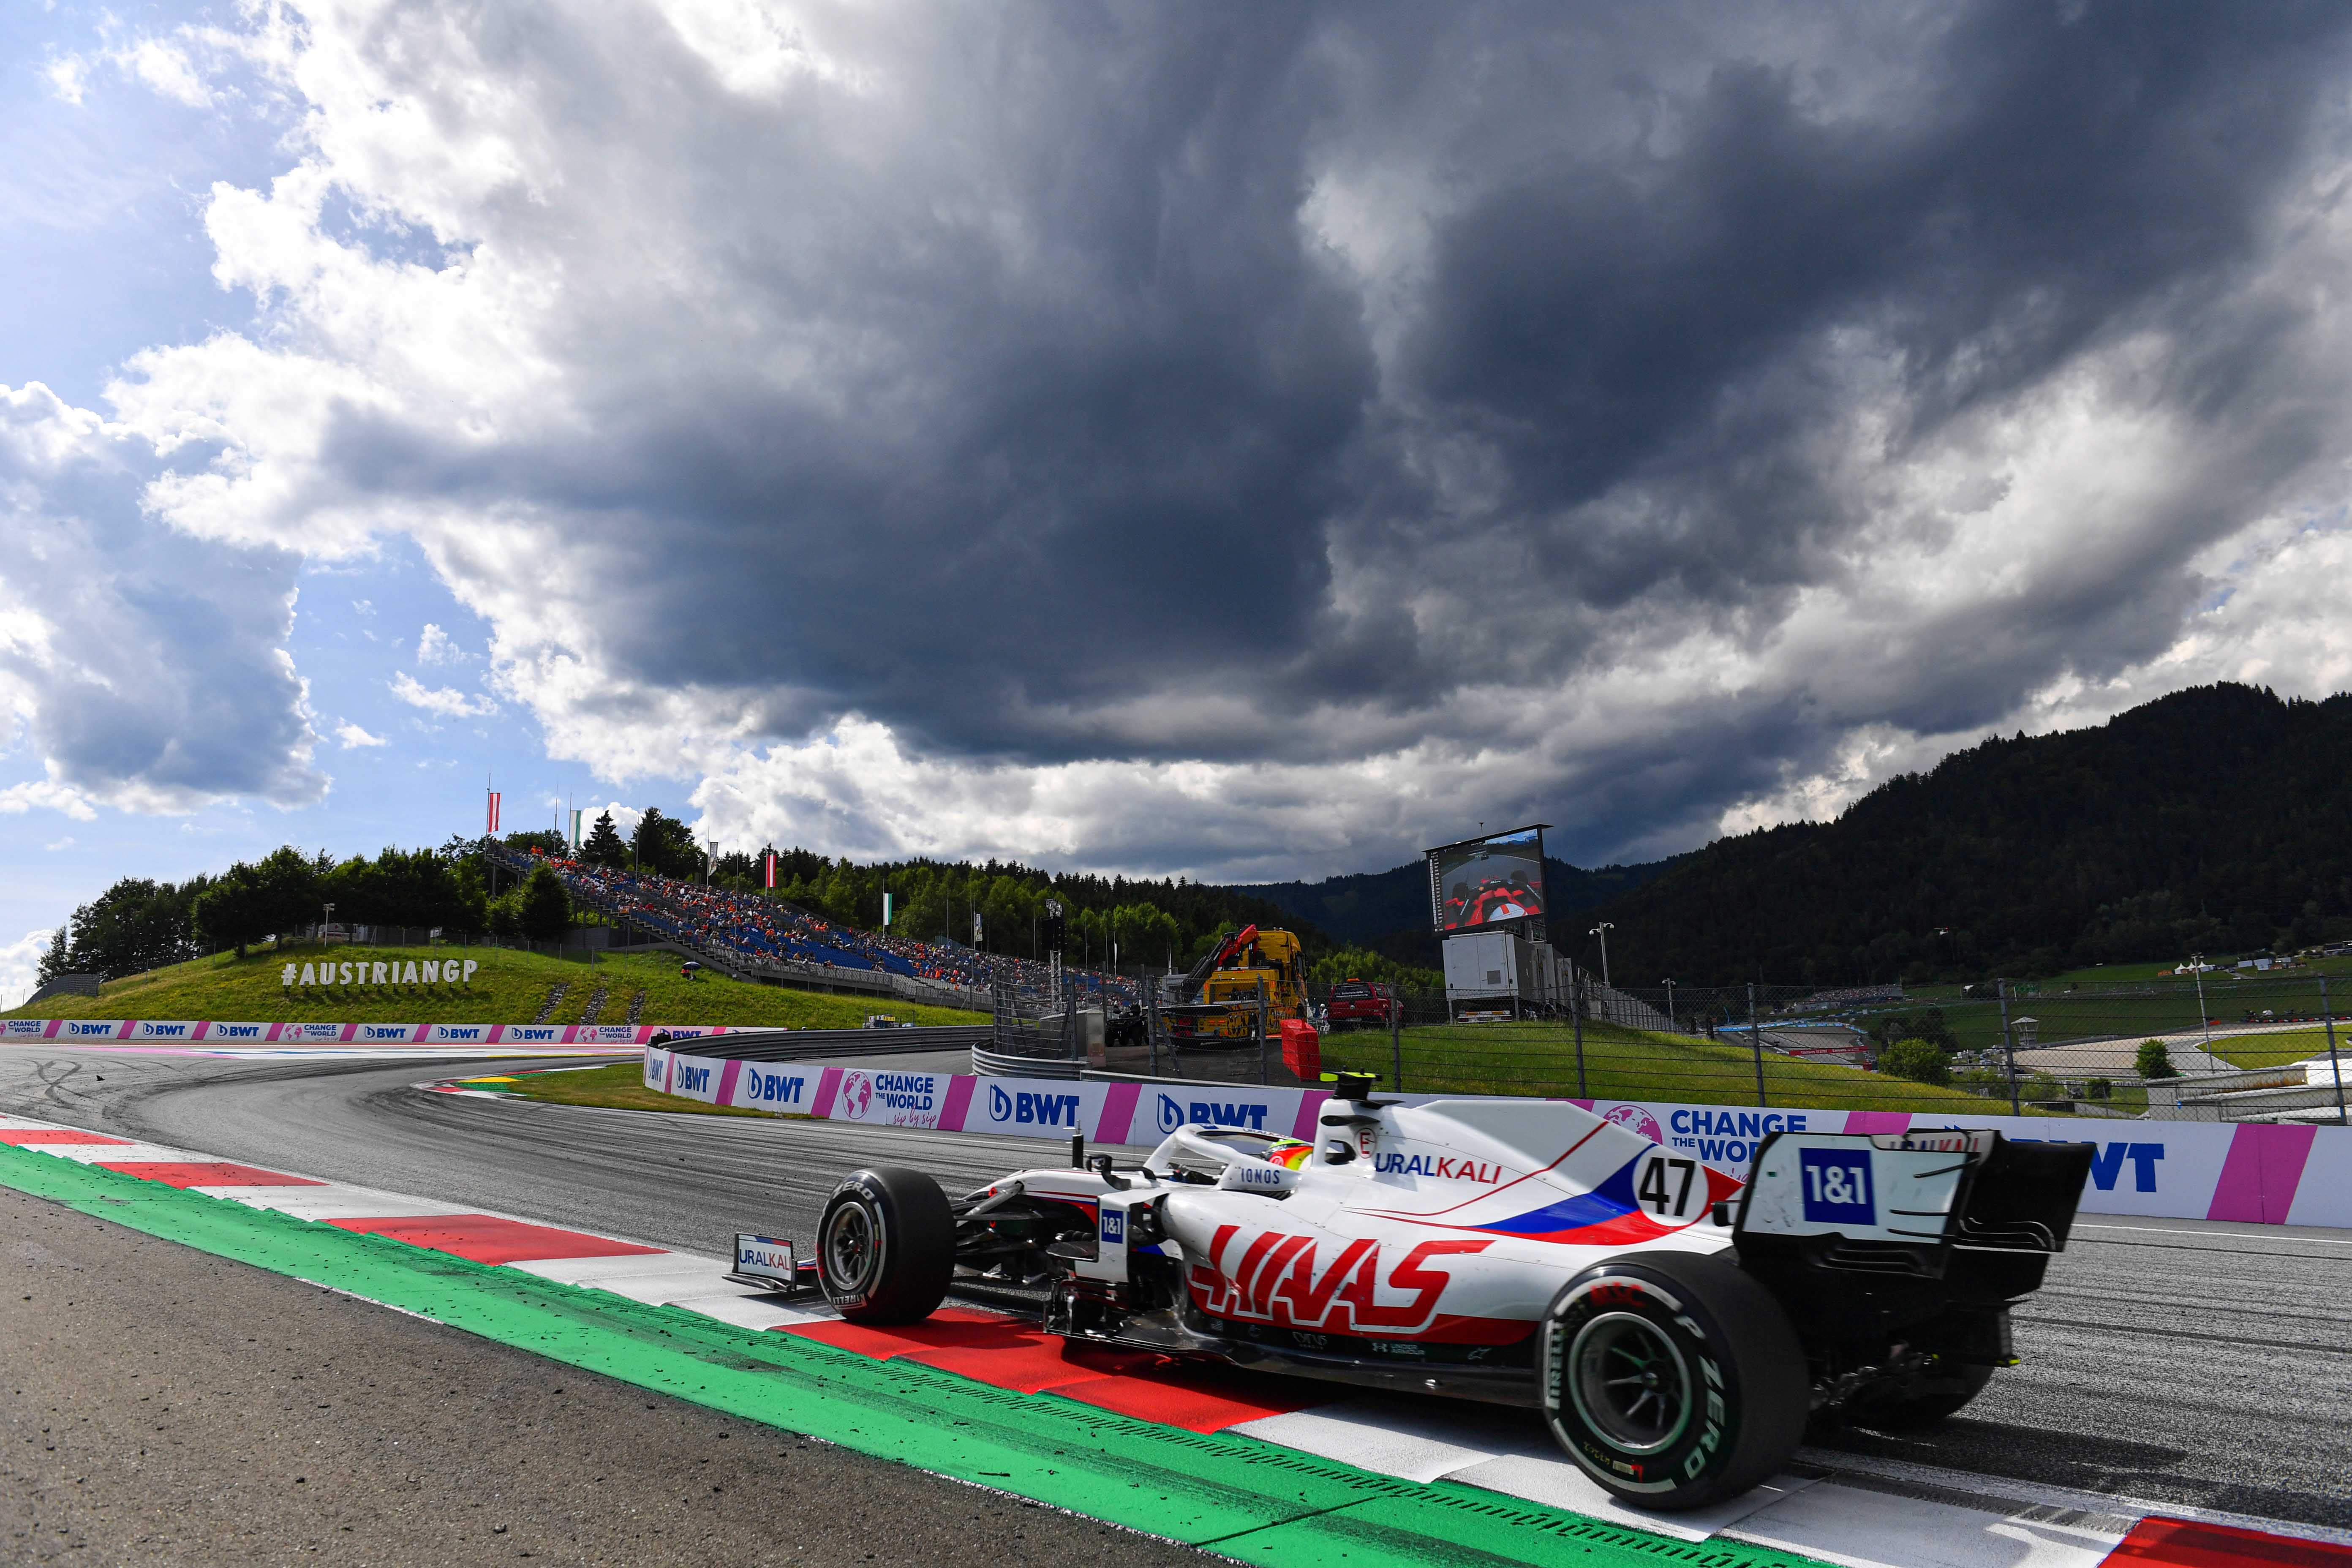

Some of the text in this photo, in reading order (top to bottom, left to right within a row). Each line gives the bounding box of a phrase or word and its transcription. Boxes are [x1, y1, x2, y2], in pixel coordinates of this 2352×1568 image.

[281, 960, 477, 986] #AUSTRIANGP
[81, 1024, 111, 1034] BWT
[155, 1025, 185, 1035] BWT
[229, 1026, 259, 1036] BWT
[377, 1028, 406, 1038] BWT
[450, 1029, 479, 1039] BWT
[524, 1030, 554, 1040] BWT
[651, 1059, 663, 1082] BWT
[685, 1066, 710, 1093] BWT
[763, 1075, 804, 1103] BWT
[876, 1074, 934, 1093] CHANGE
[886, 1093, 933, 1111] WORLD
[1016, 1092, 1079, 1126] BWT
[893, 1104, 937, 1129] sip by sip
[1190, 1102, 1267, 1130] BWT
[1670, 1110, 1806, 1138] CHANGE
[1361, 1132, 1370, 1154] E
[1672, 1138, 1695, 1147] THE
[1241, 1168, 1280, 1184] IONOS
[1375, 1153, 1502, 1184] URALKALI
[832, 1181, 875, 1200] ZERO
[1639, 1157, 1696, 1217] 47
[1805, 1165, 1867, 1205] 1&1
[1102, 1217, 1121, 1235] 1&1
[739, 1249, 791, 1271] URALKALI
[1191, 1225, 1497, 1334] HAAS
[833, 1293, 867, 1310] PIRELLI
[1543, 1318, 1563, 1410] PIRELLI
[1683, 1355, 1726, 1480] ZERO
